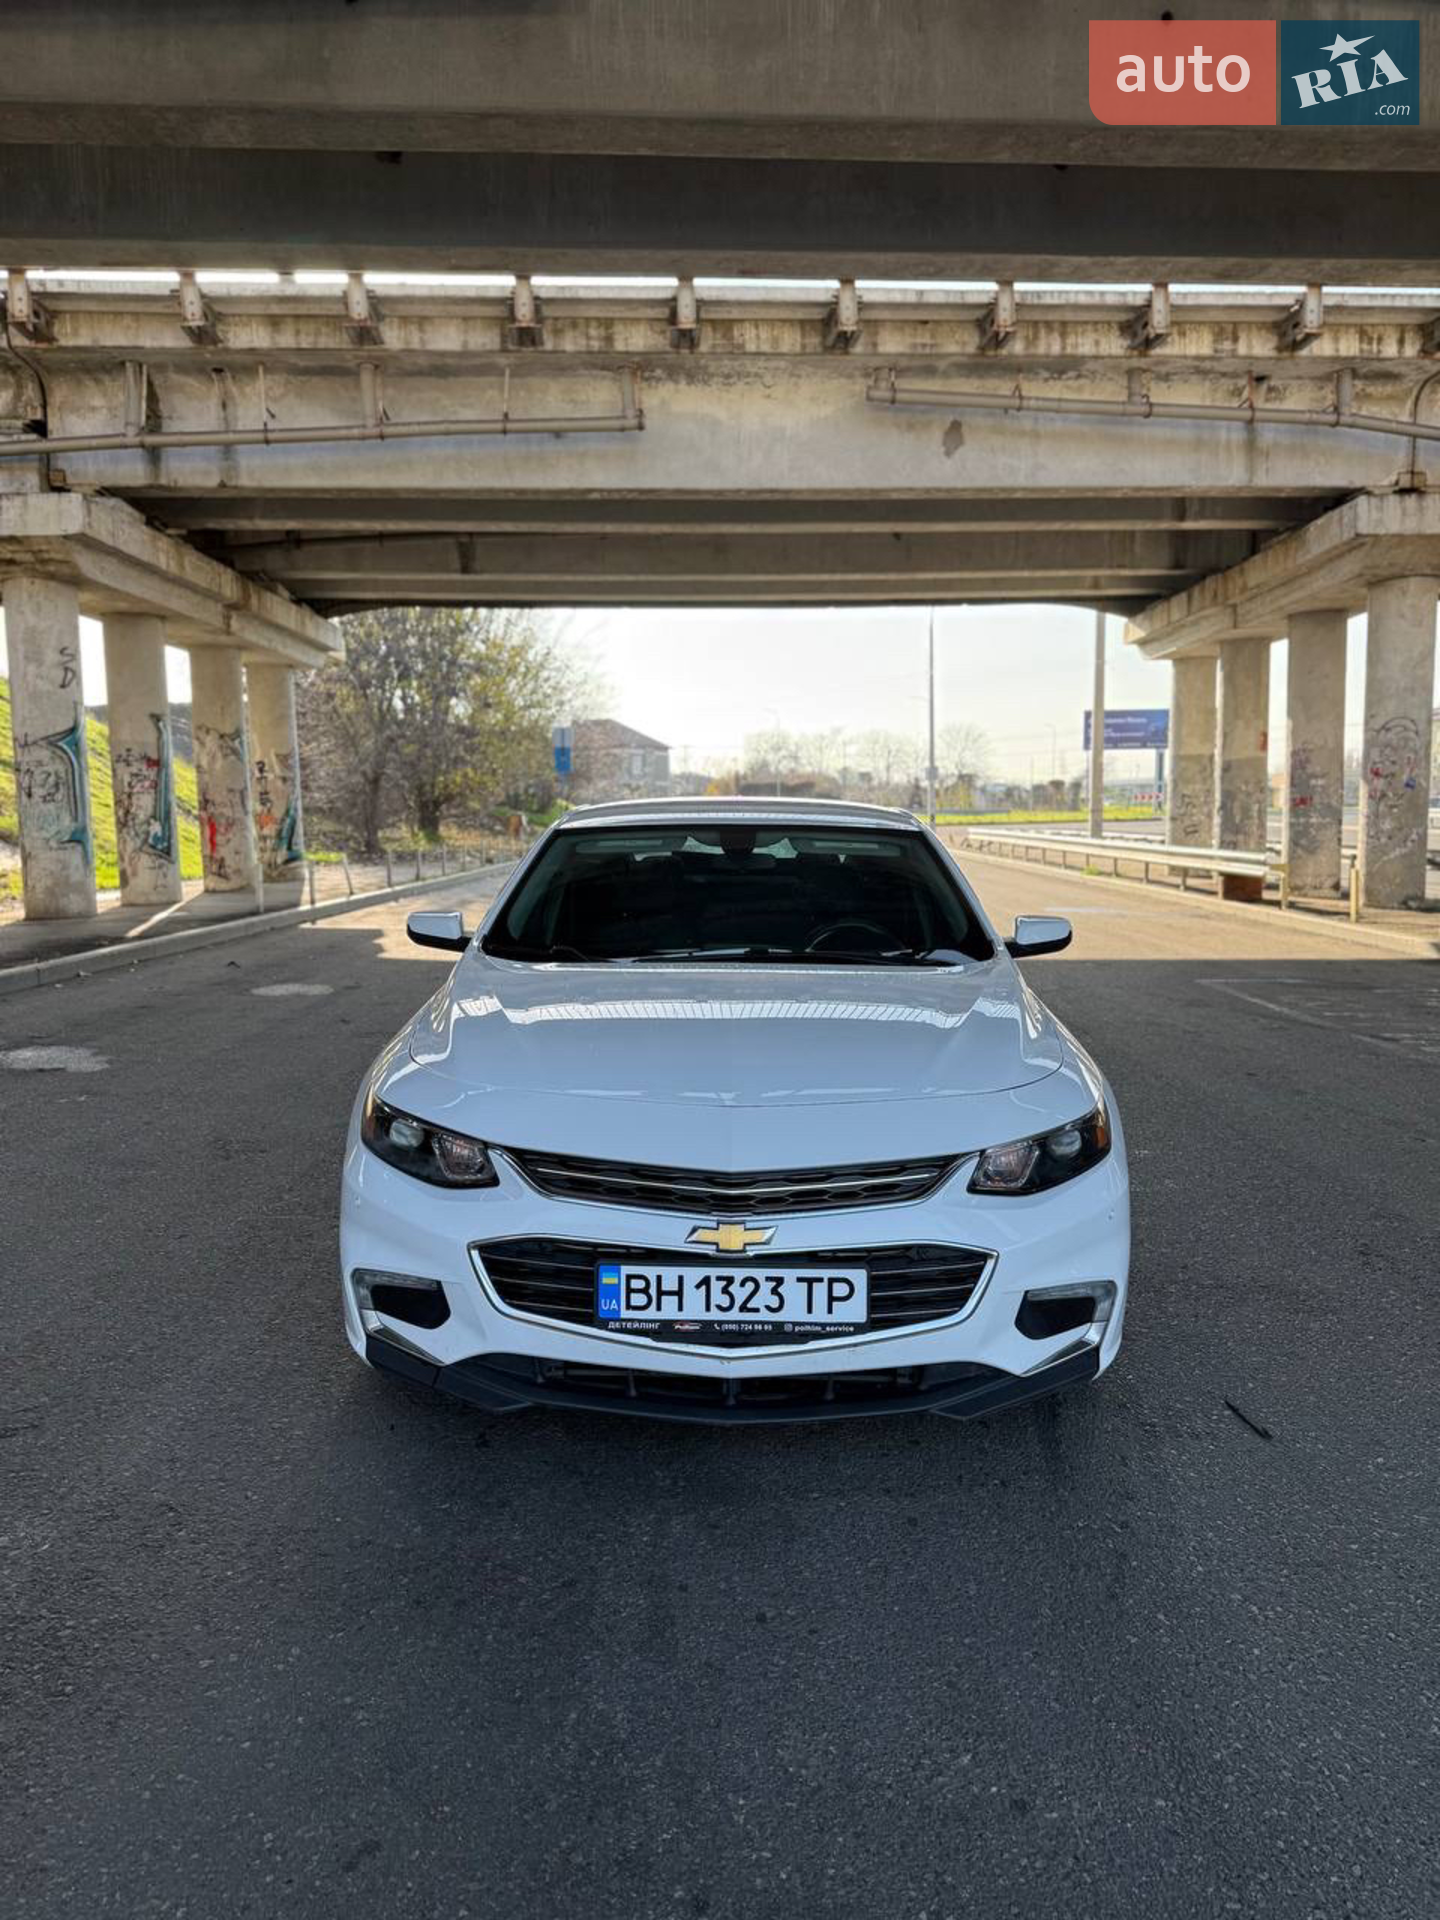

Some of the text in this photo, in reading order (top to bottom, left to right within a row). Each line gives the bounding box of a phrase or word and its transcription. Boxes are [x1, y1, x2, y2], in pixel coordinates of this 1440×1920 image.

[600, 1298, 619, 1311] UA
[624, 1273, 856, 1315] BH 1323 TP
